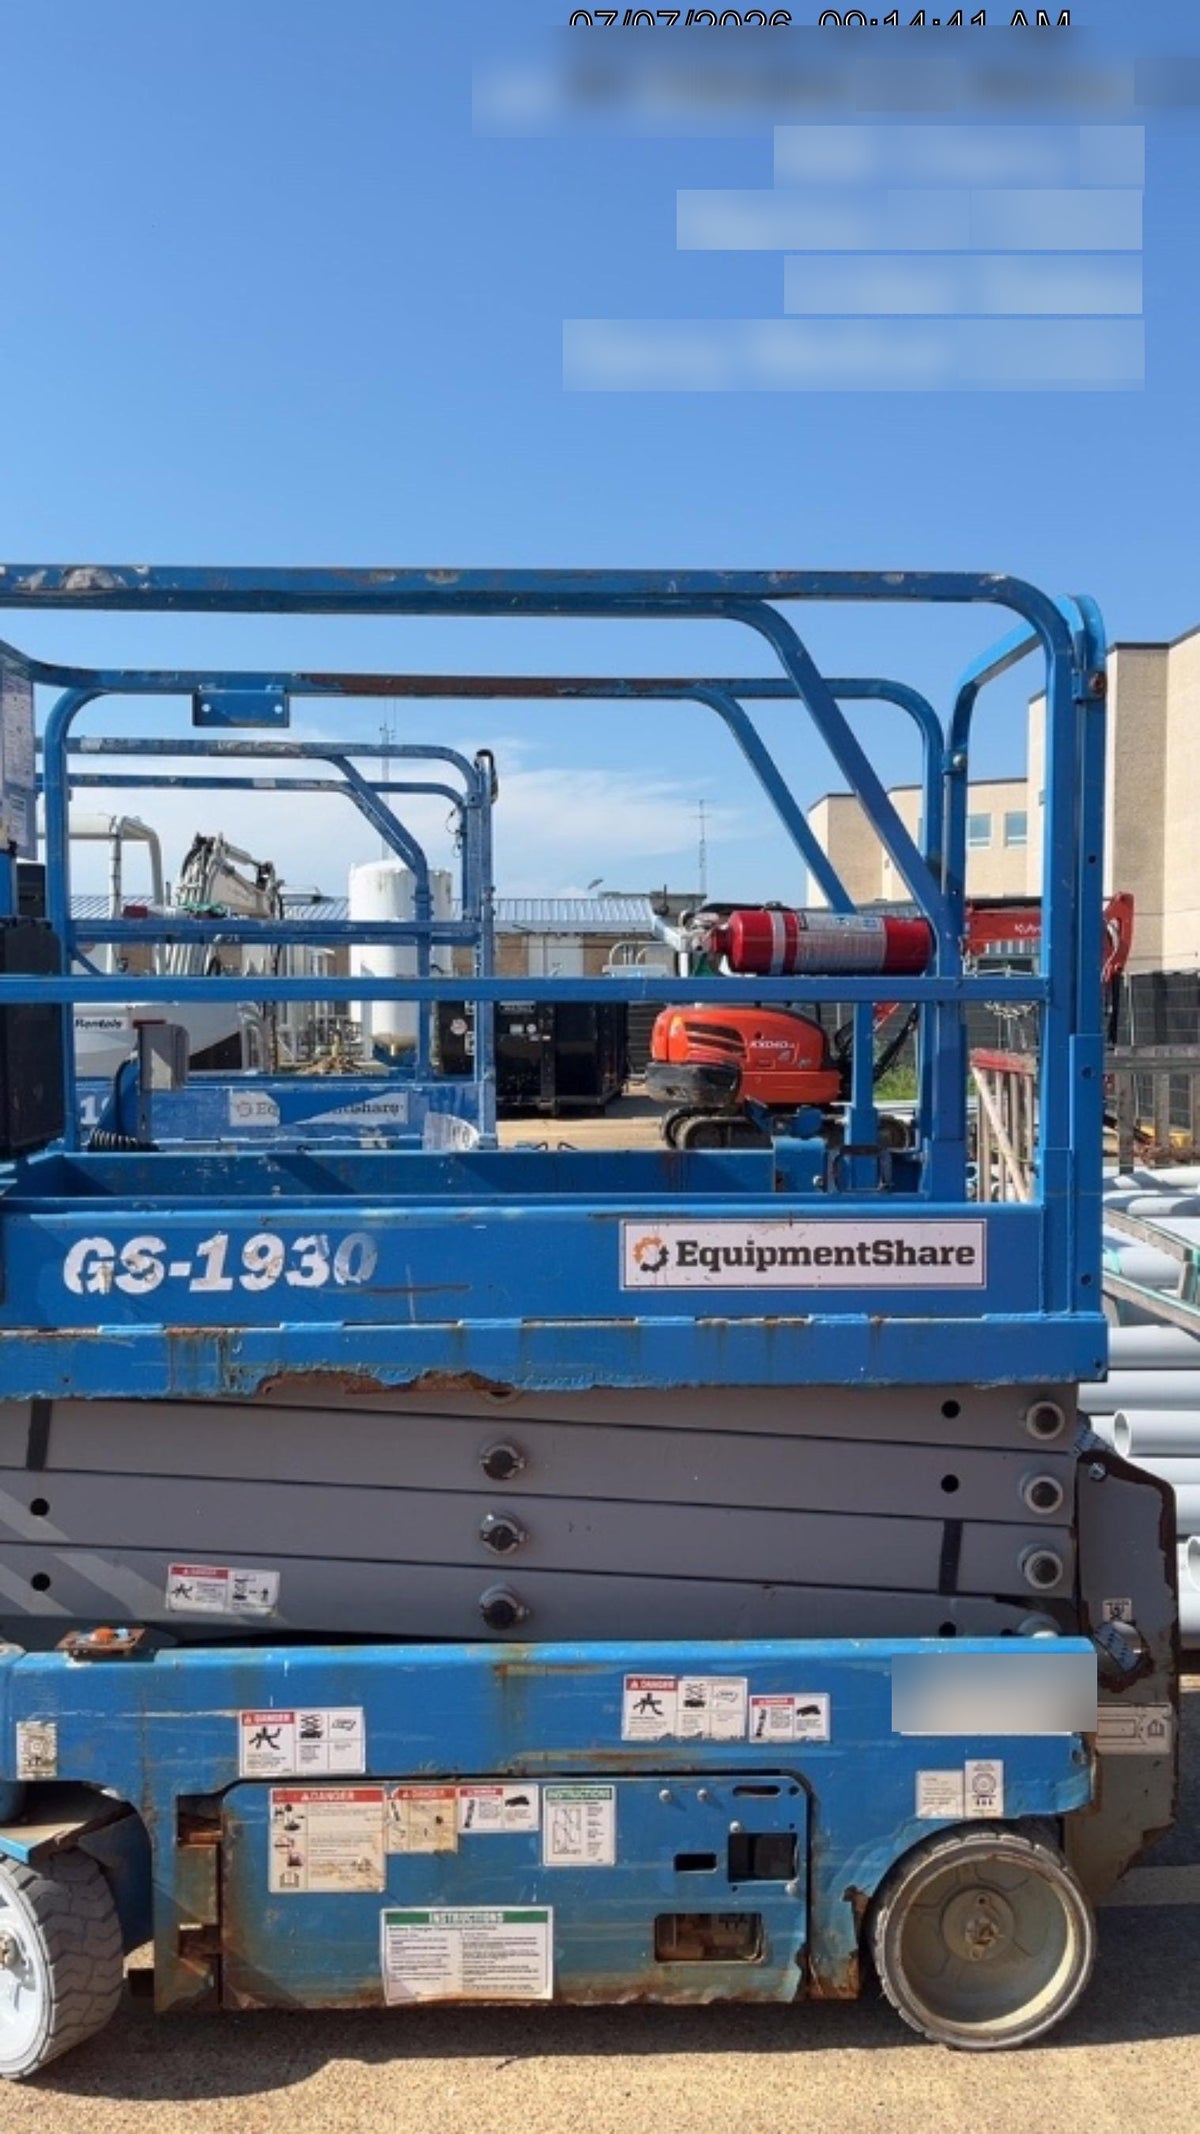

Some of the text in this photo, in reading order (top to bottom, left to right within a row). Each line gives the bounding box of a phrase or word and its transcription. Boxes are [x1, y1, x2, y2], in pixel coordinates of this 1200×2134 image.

[675, 1239, 976, 1272] EquipmentShare
[63, 1231, 378, 1294] GS-1930
[639, 1680, 675, 1690] DANGER
[255, 1713, 292, 1723] DANGER
[309, 1791, 355, 1801] DANGER
[411, 1789, 445, 1799] DANGER
